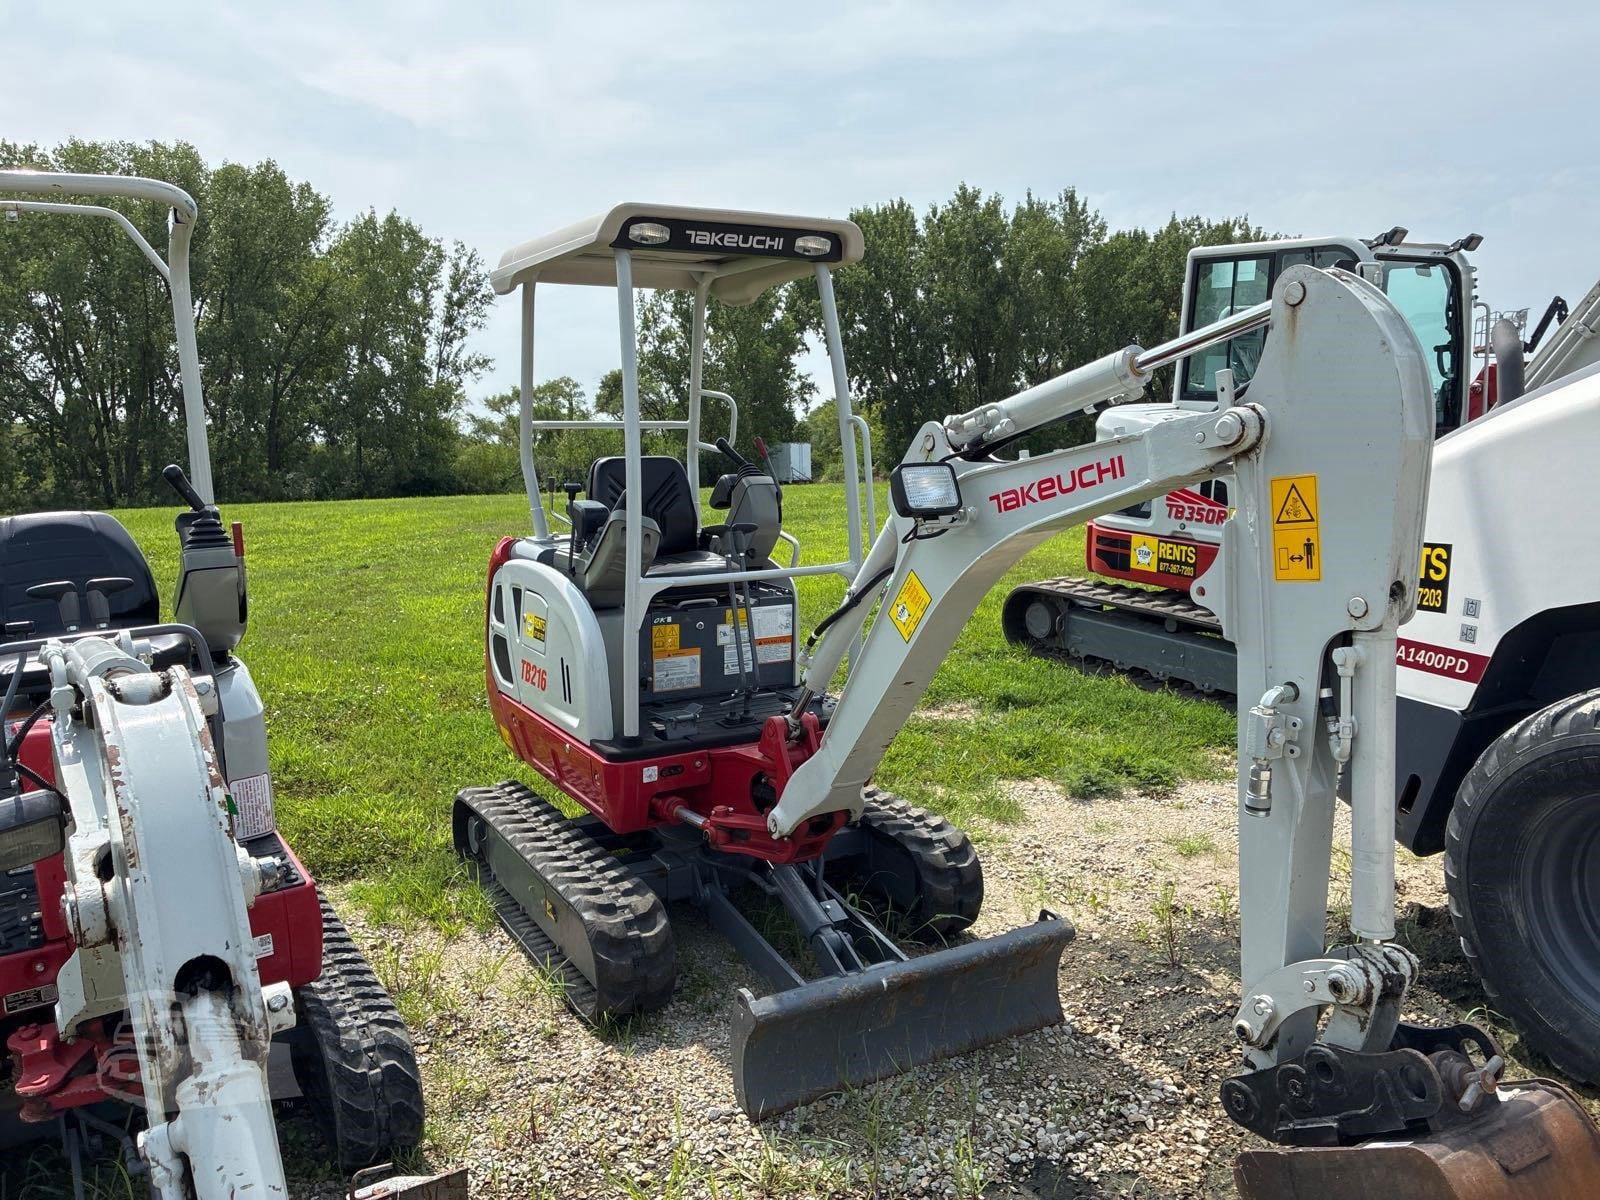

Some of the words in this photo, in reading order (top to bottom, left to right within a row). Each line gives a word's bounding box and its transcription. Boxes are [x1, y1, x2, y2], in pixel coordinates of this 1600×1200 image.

[685, 229, 785, 250] TAKEUCHI
[988, 455, 1126, 514] TAKEUCHI
[1165, 503, 1229, 525] TB350R
[1137, 549, 1151, 558] STAR
[1158, 542, 1196, 564] RENTS
[521, 658, 548, 692] TB216
